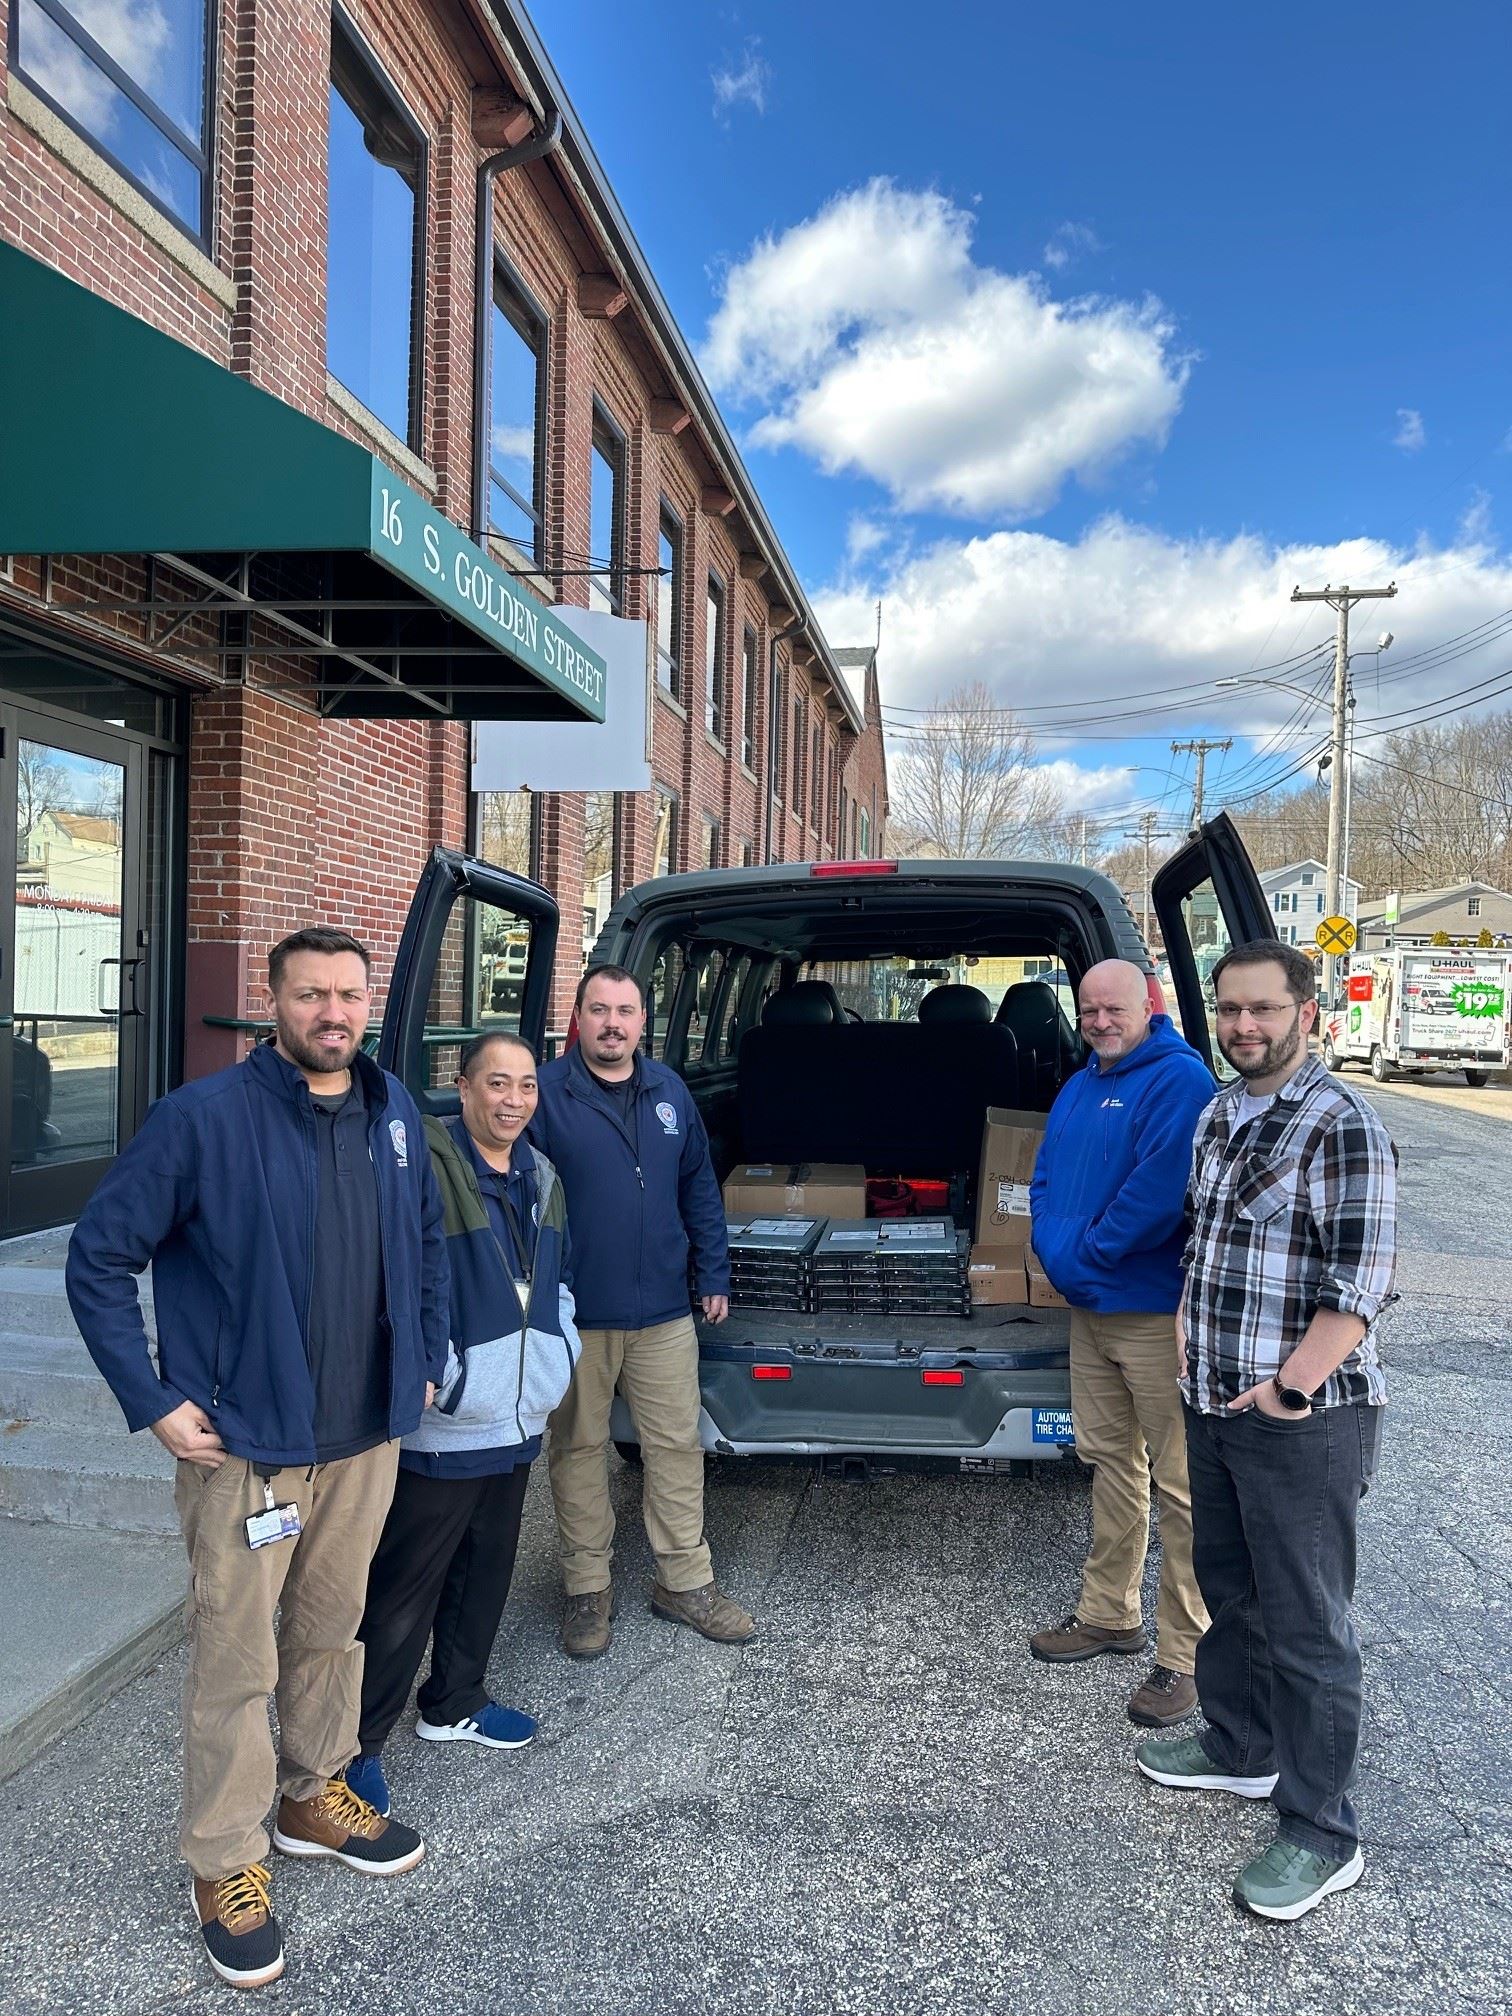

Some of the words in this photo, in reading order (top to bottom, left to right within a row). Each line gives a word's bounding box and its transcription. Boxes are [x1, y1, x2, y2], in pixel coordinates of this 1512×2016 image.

[380, 488, 403, 546] 16
[423, 524, 446, 582] S.
[454, 551, 539, 653] GOLDEN
[543, 625, 603, 703] STREET
[1319, 930, 1328, 940] R
[1345, 931, 1354, 941] R
[1035, 1423, 1054, 1435] TIRE
